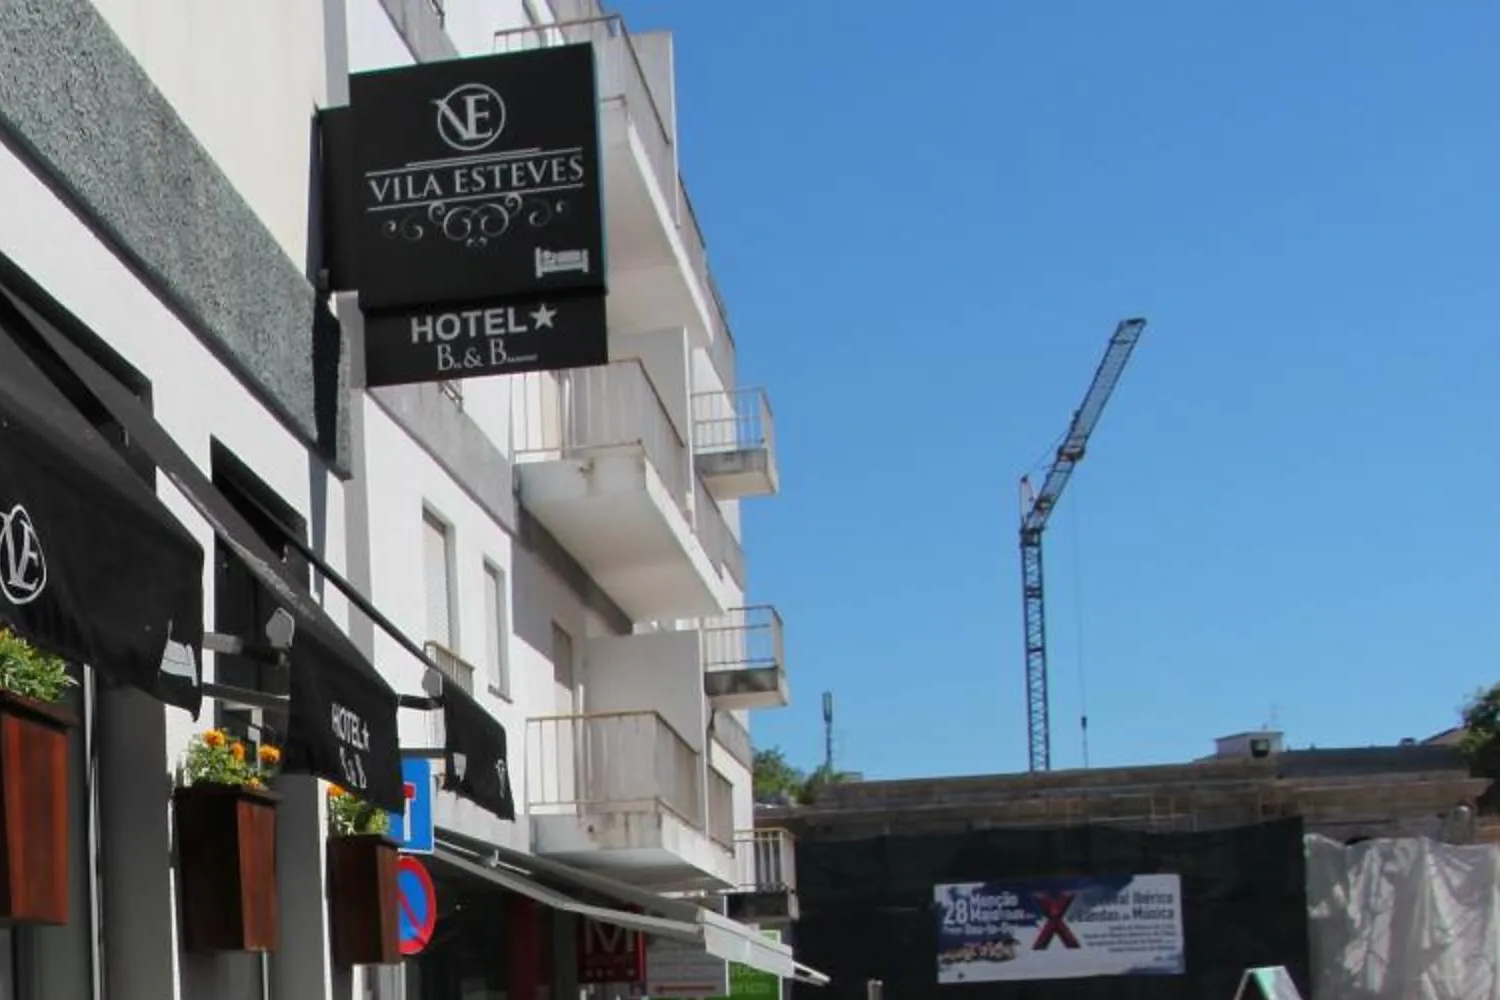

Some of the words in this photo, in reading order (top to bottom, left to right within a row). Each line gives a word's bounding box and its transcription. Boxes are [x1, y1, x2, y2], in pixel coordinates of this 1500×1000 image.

[368, 174, 444, 202] VILA
[453, 154, 585, 195] ESTEVES
[410, 306, 528, 344] HOTEL
[463, 346, 484, 369] &
[331, 702, 365, 751] HOTEL
[943, 898, 968, 925] 28
[1031, 890, 1081, 950] X
